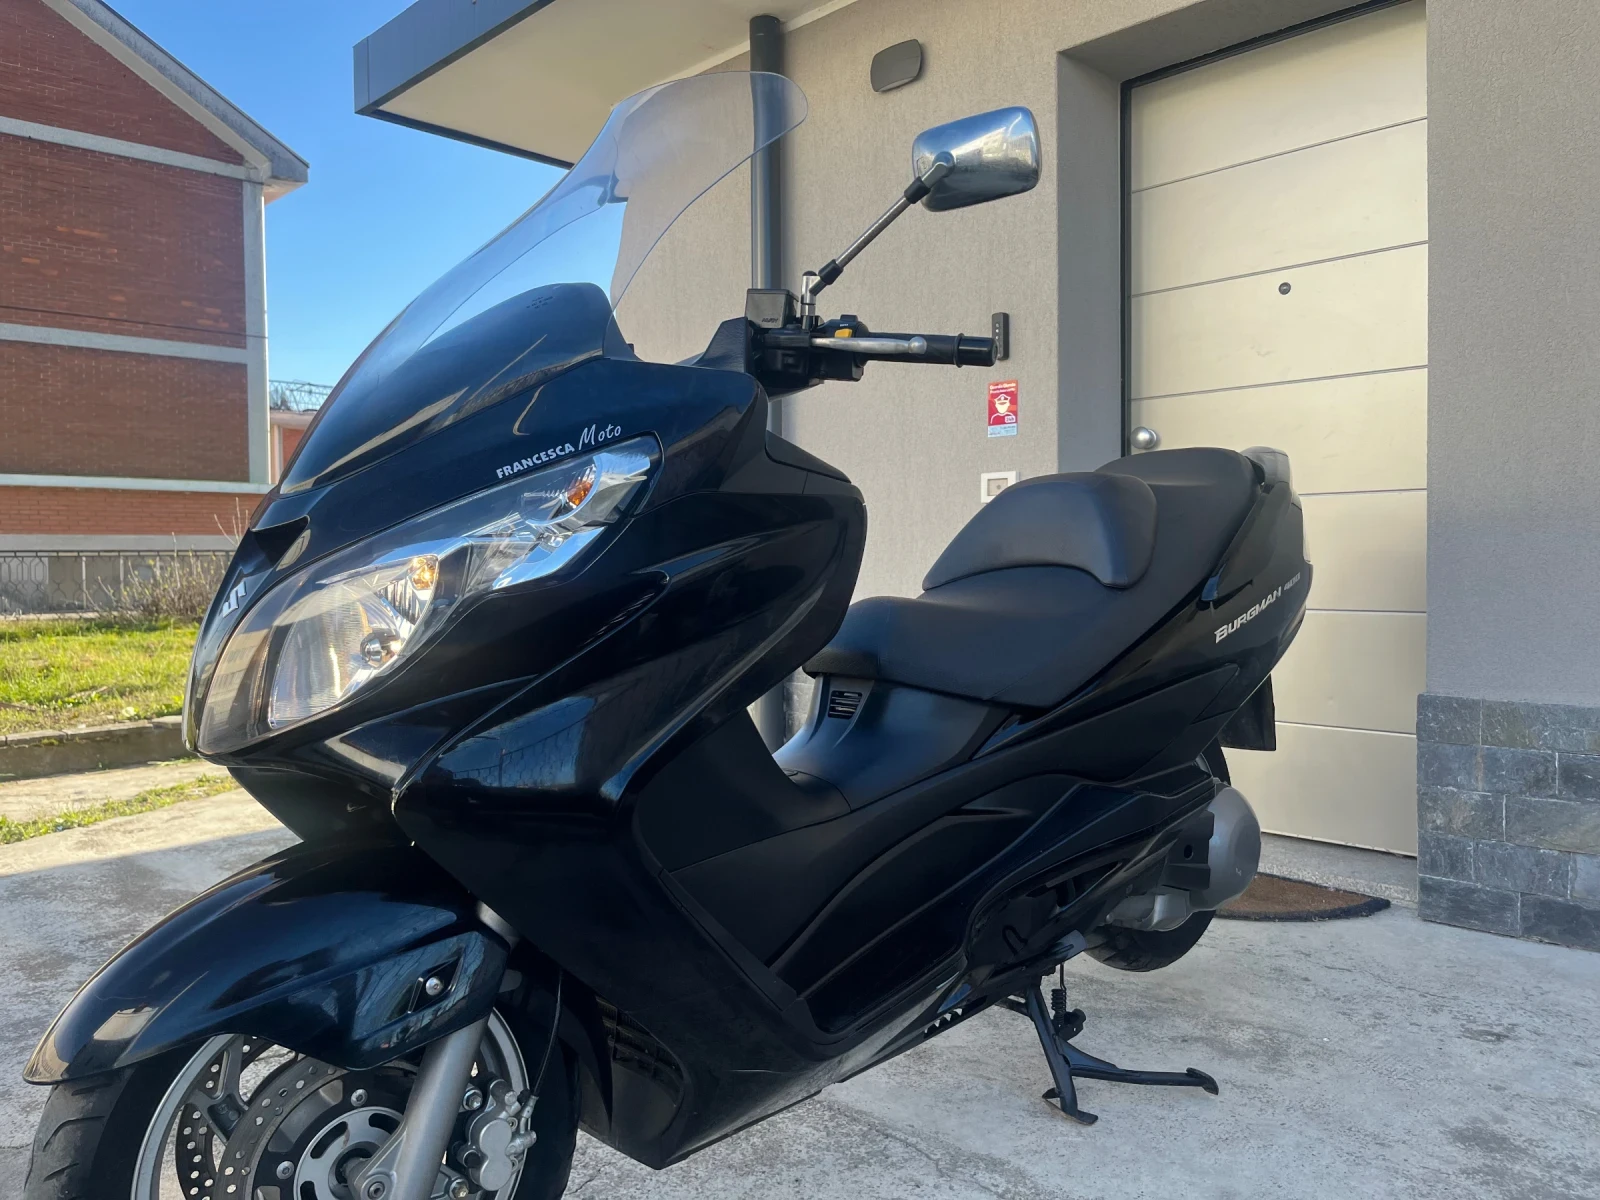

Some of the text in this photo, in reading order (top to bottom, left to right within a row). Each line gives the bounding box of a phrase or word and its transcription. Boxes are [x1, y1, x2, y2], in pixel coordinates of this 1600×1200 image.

[496, 423, 622, 479] FRANCESCA Moto
[1214, 586, 1282, 644] BURGMAN
